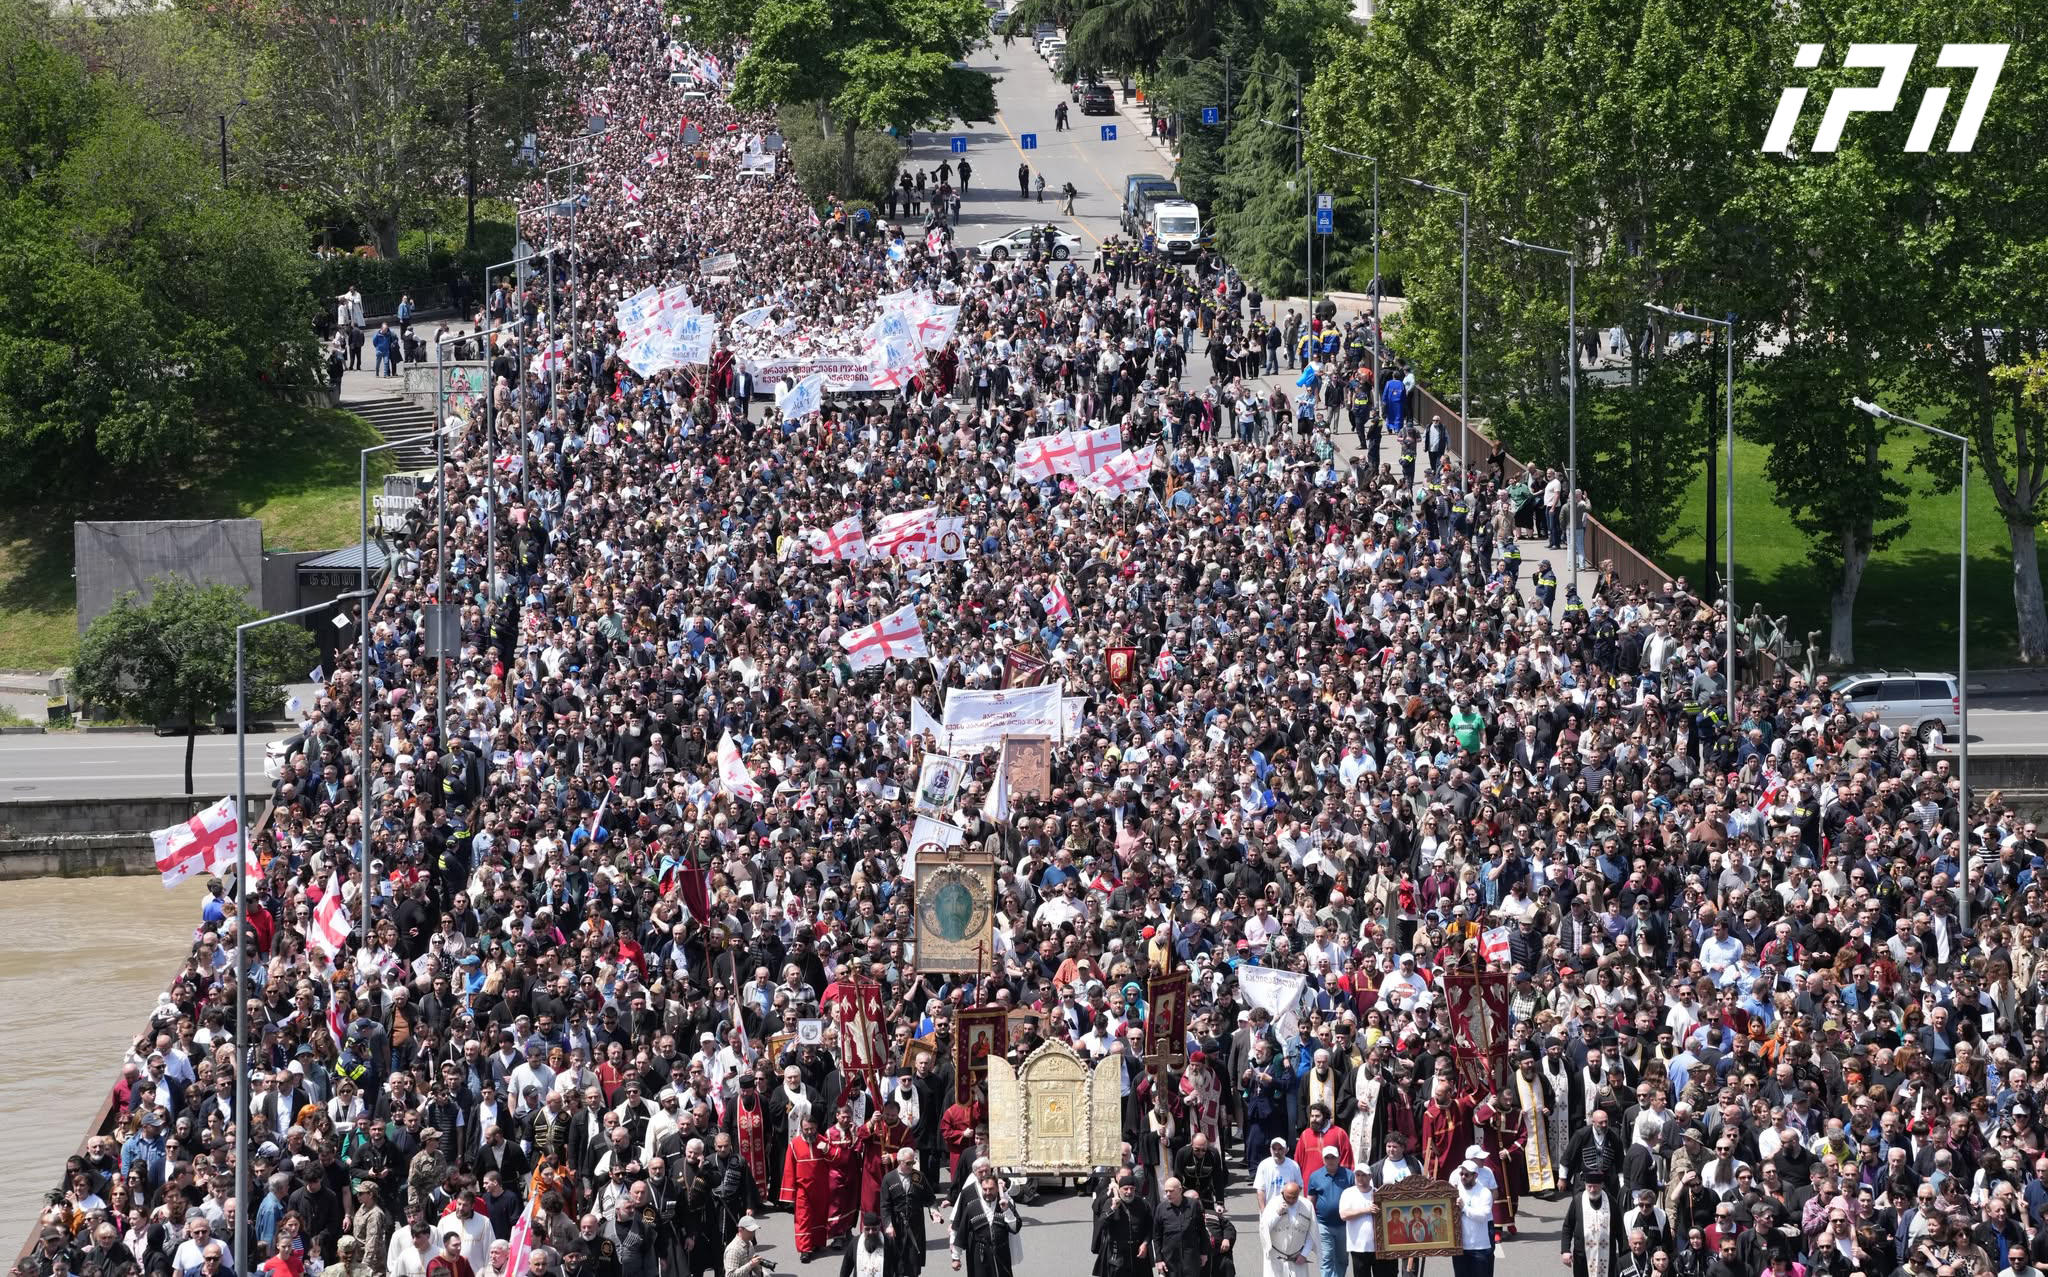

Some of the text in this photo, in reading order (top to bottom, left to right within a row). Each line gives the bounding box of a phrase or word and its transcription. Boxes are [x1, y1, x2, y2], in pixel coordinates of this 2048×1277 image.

[762, 364, 868, 375] მრავალვილიანი ოჯახი
[762, 375, 781, 383] ჩვენ
